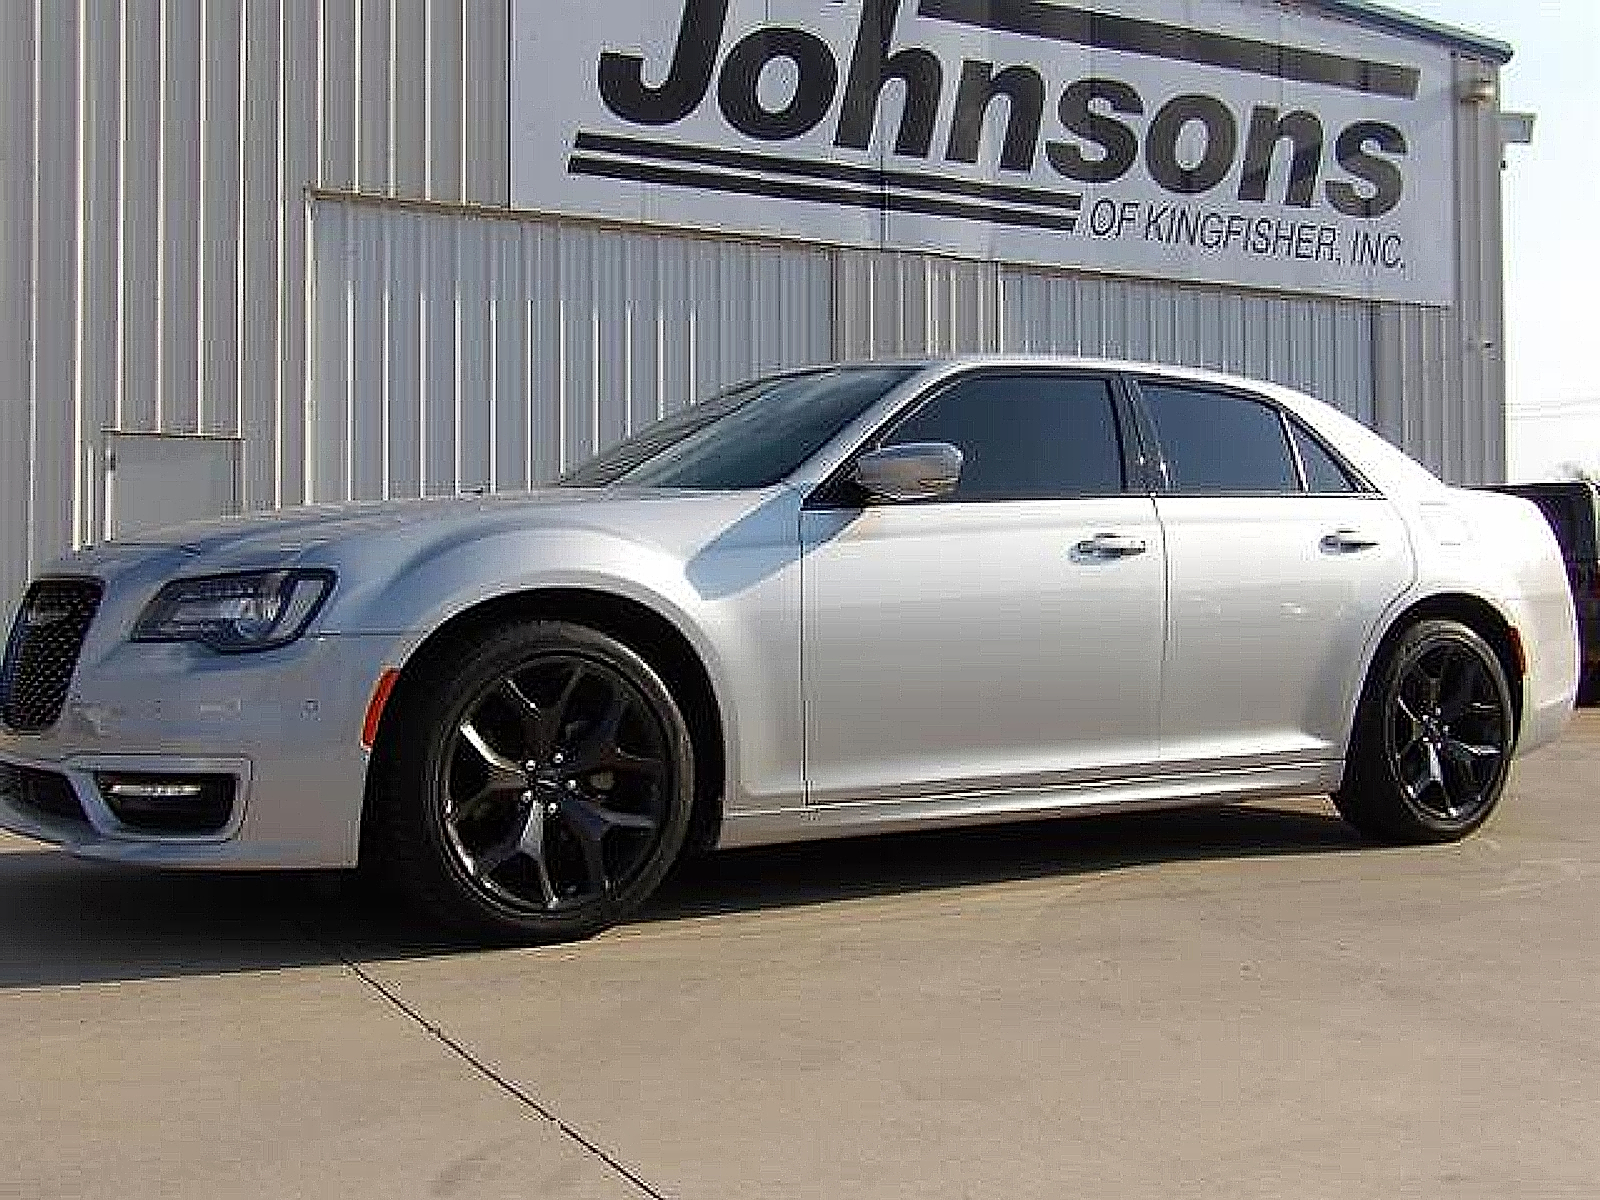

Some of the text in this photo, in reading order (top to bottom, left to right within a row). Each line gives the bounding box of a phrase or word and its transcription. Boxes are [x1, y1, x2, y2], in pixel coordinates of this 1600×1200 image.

[598, 0, 1407, 217] Johnsons
[1091, 199, 1139, 236] OF
[1350, 228, 1405, 270] INC.
